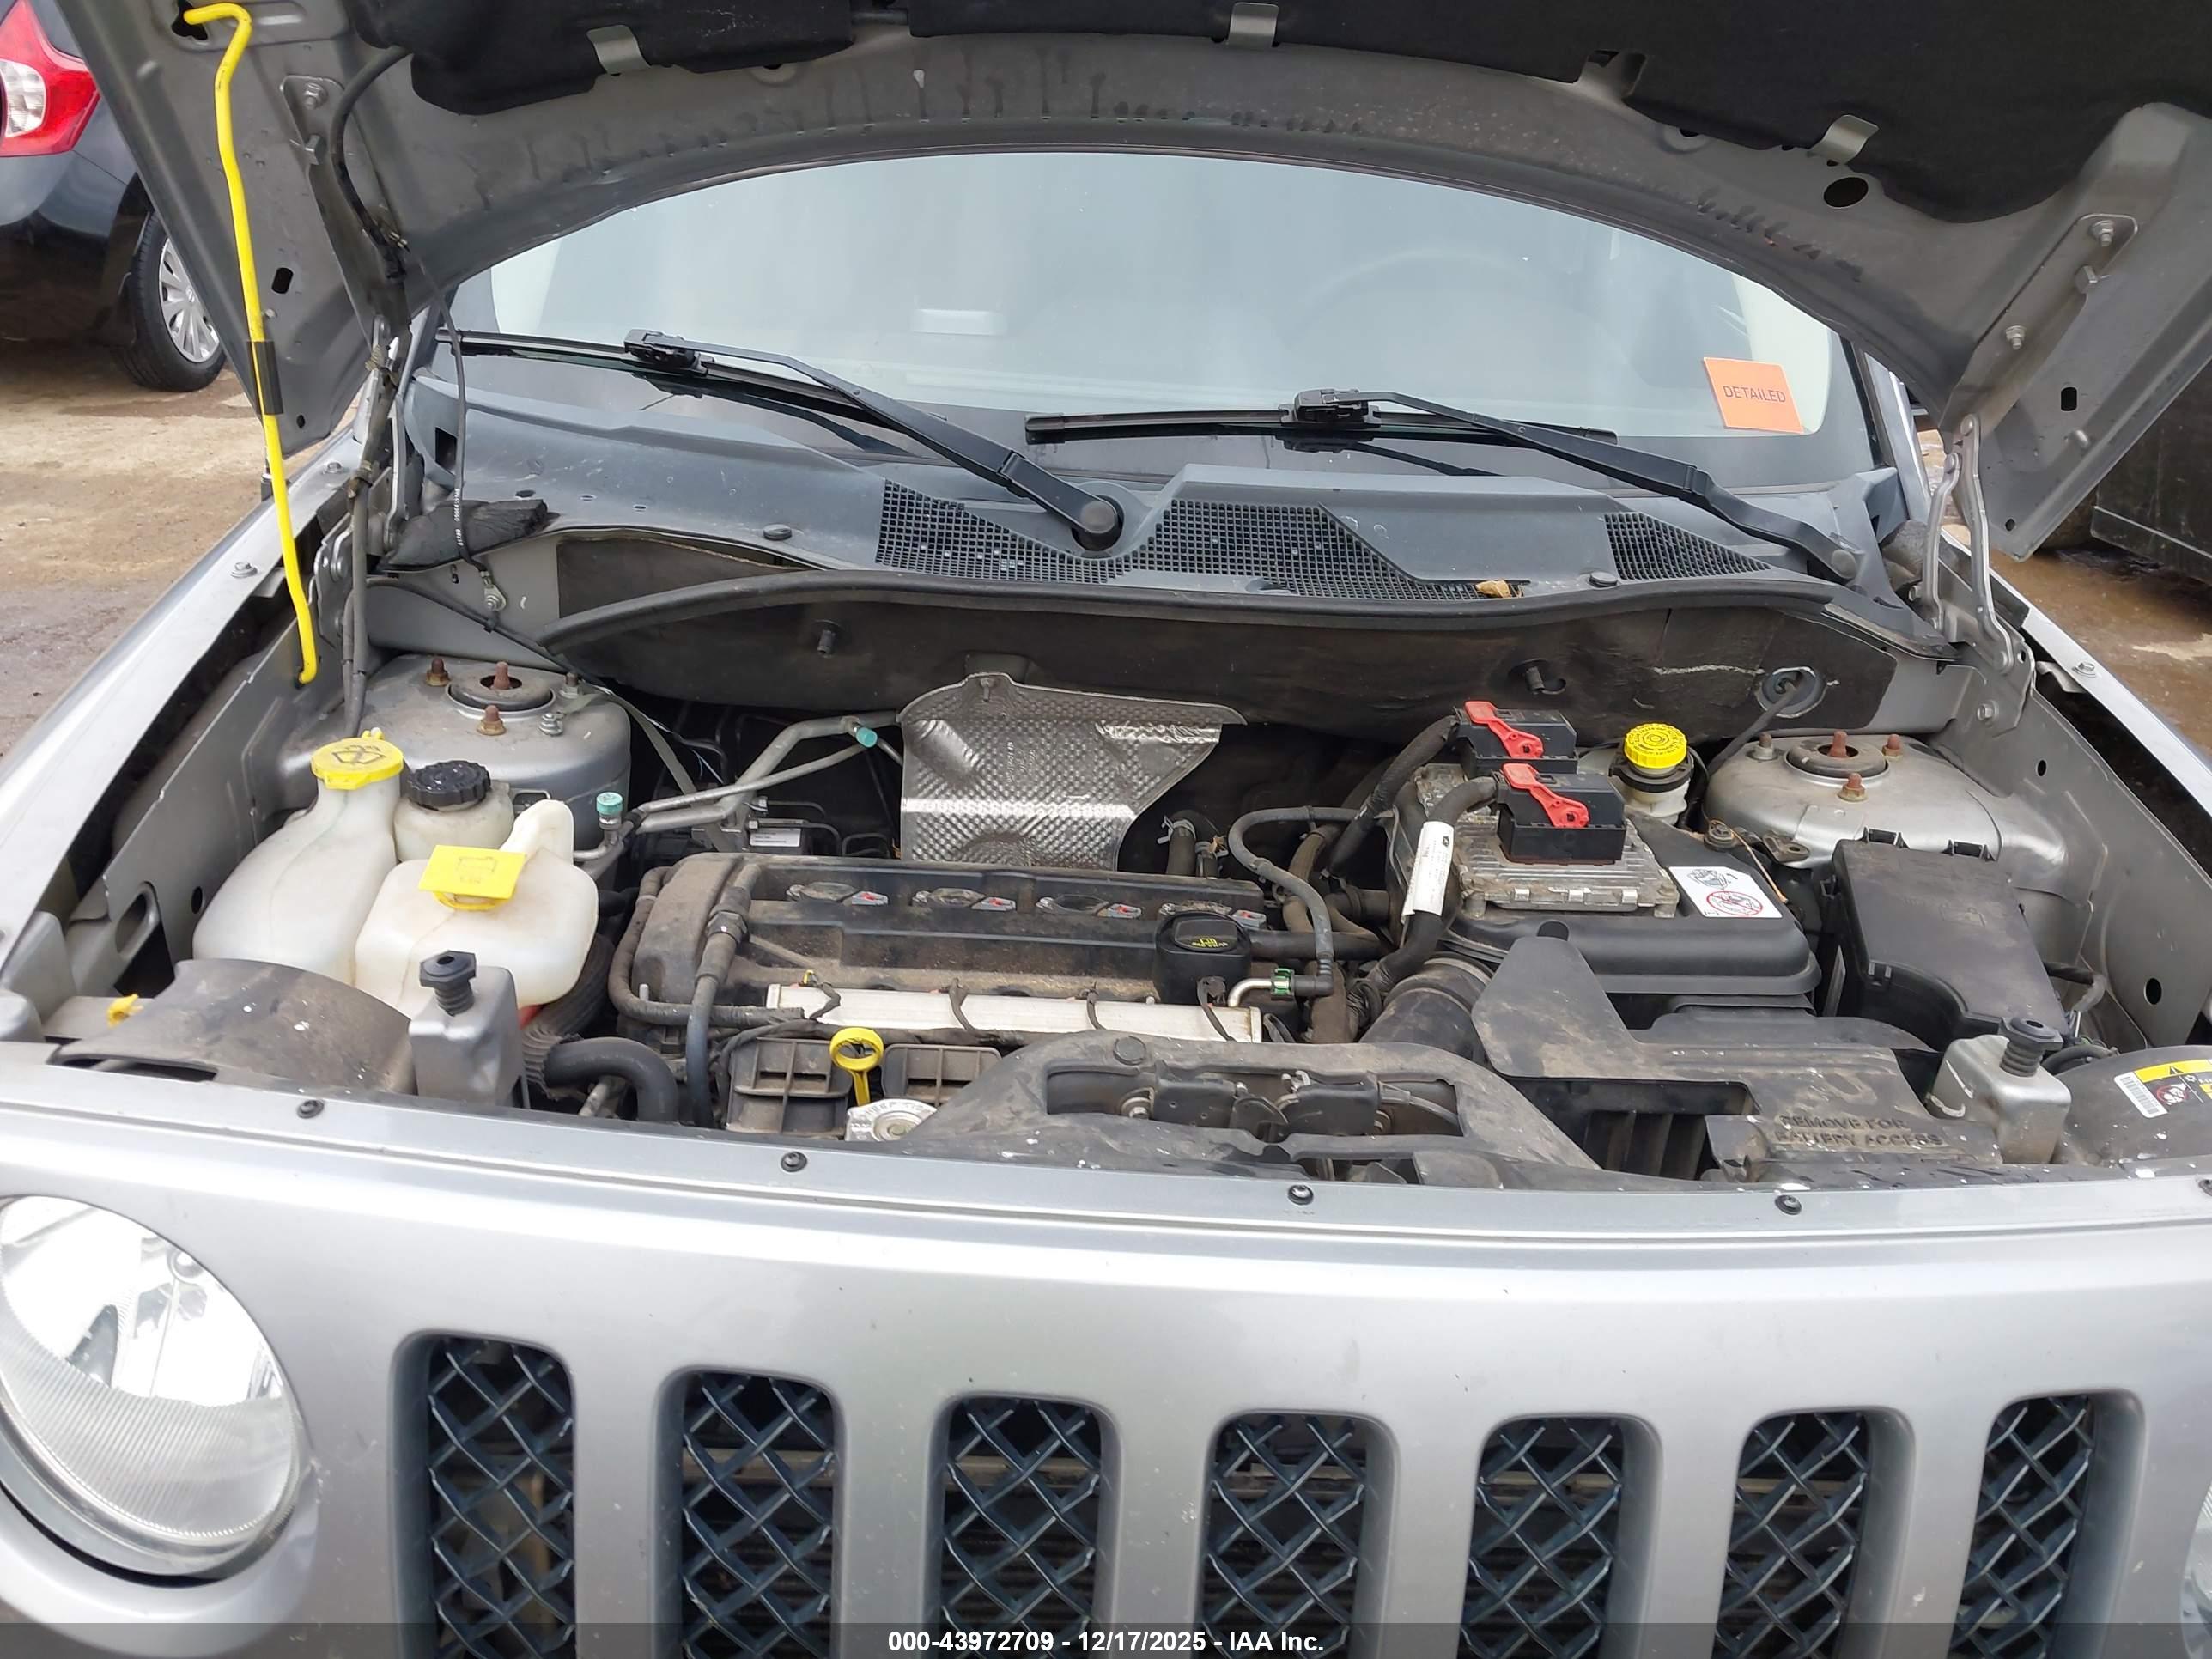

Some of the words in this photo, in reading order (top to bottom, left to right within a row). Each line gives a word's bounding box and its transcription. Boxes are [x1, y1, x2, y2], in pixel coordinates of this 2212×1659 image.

[1723, 386, 1786, 403] DETAILED
[1780, 1115, 1863, 1130] REMOVE
[1865, 1118, 1910, 1130] FOR
[1774, 1130, 1856, 1146] BATTERY
[1864, 1133, 1944, 1146] ACCESS
